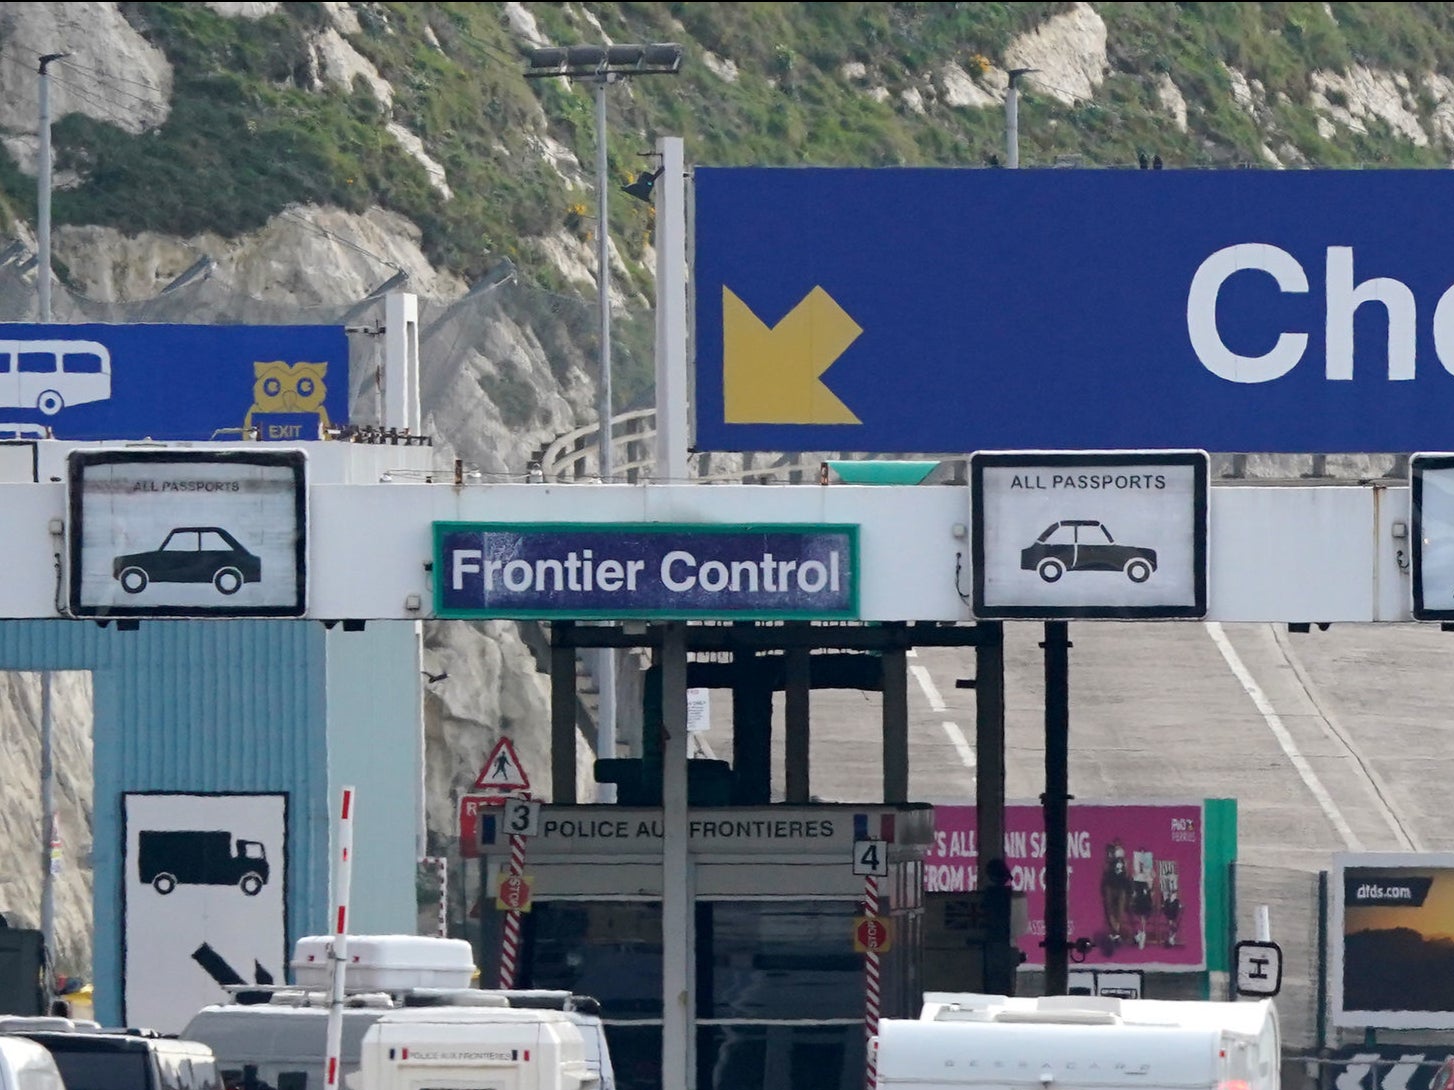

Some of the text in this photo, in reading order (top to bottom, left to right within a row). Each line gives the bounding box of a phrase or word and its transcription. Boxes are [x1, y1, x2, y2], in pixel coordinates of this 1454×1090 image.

[268, 424, 302, 438] EXIT
[133, 480, 240, 492] ALL PASSPORTS
[1010, 474, 1166, 489] ALL PASSPORTS
[452, 549, 839, 593] Frontier Control
[511, 805, 530, 831] 3
[544, 820, 834, 838] POLICE AU FRONTIERES
[949, 830, 978, 857] ALL
[1004, 831, 1027, 858] AIN
[1030, 830, 1091, 858] SANG
[861, 845, 879, 870] 4
[1357, 884, 1412, 898] dfds.com
[867, 921, 878, 950] STOP
